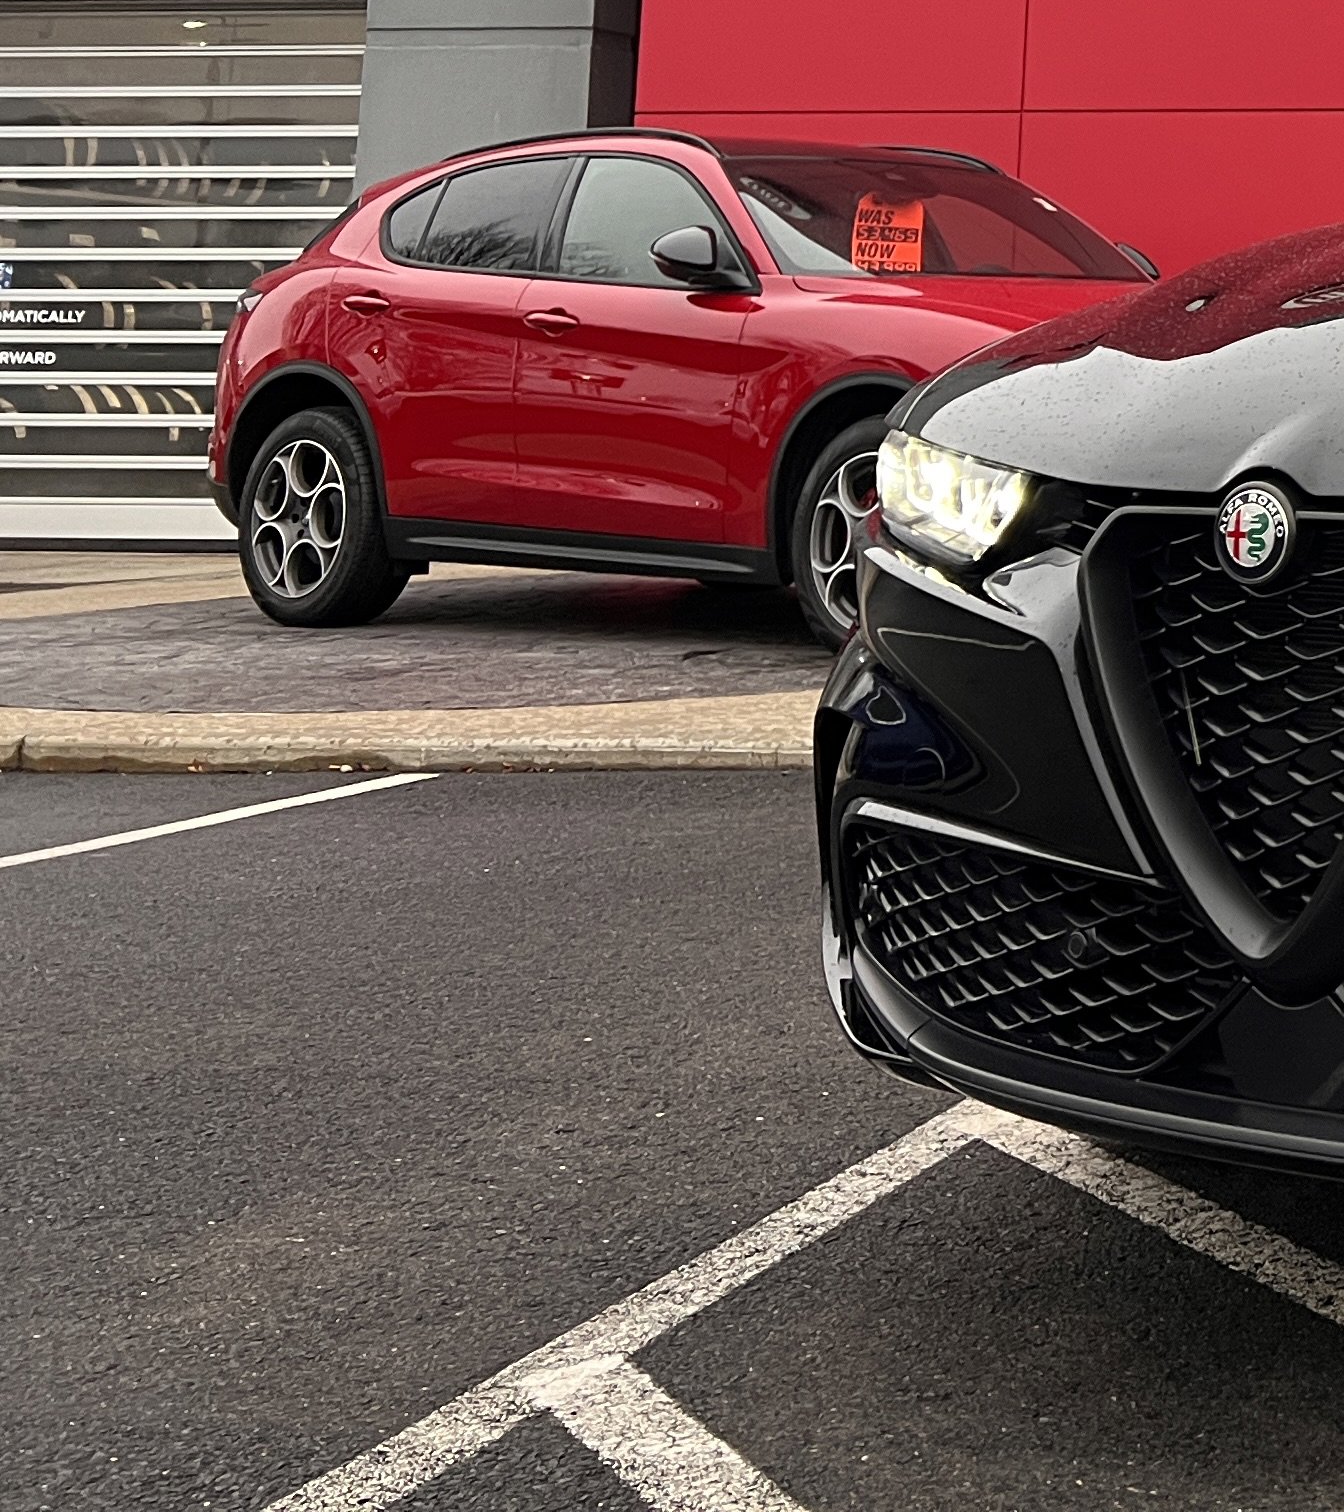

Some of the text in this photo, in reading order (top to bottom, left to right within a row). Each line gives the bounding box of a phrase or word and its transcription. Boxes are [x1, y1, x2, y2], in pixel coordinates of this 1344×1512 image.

[858, 208, 895, 225] WAS
[855, 242, 897, 259] NOW
[0, 309, 86, 323] MATICALLY
[1219, 492, 1285, 538] ALFA ROMEO
